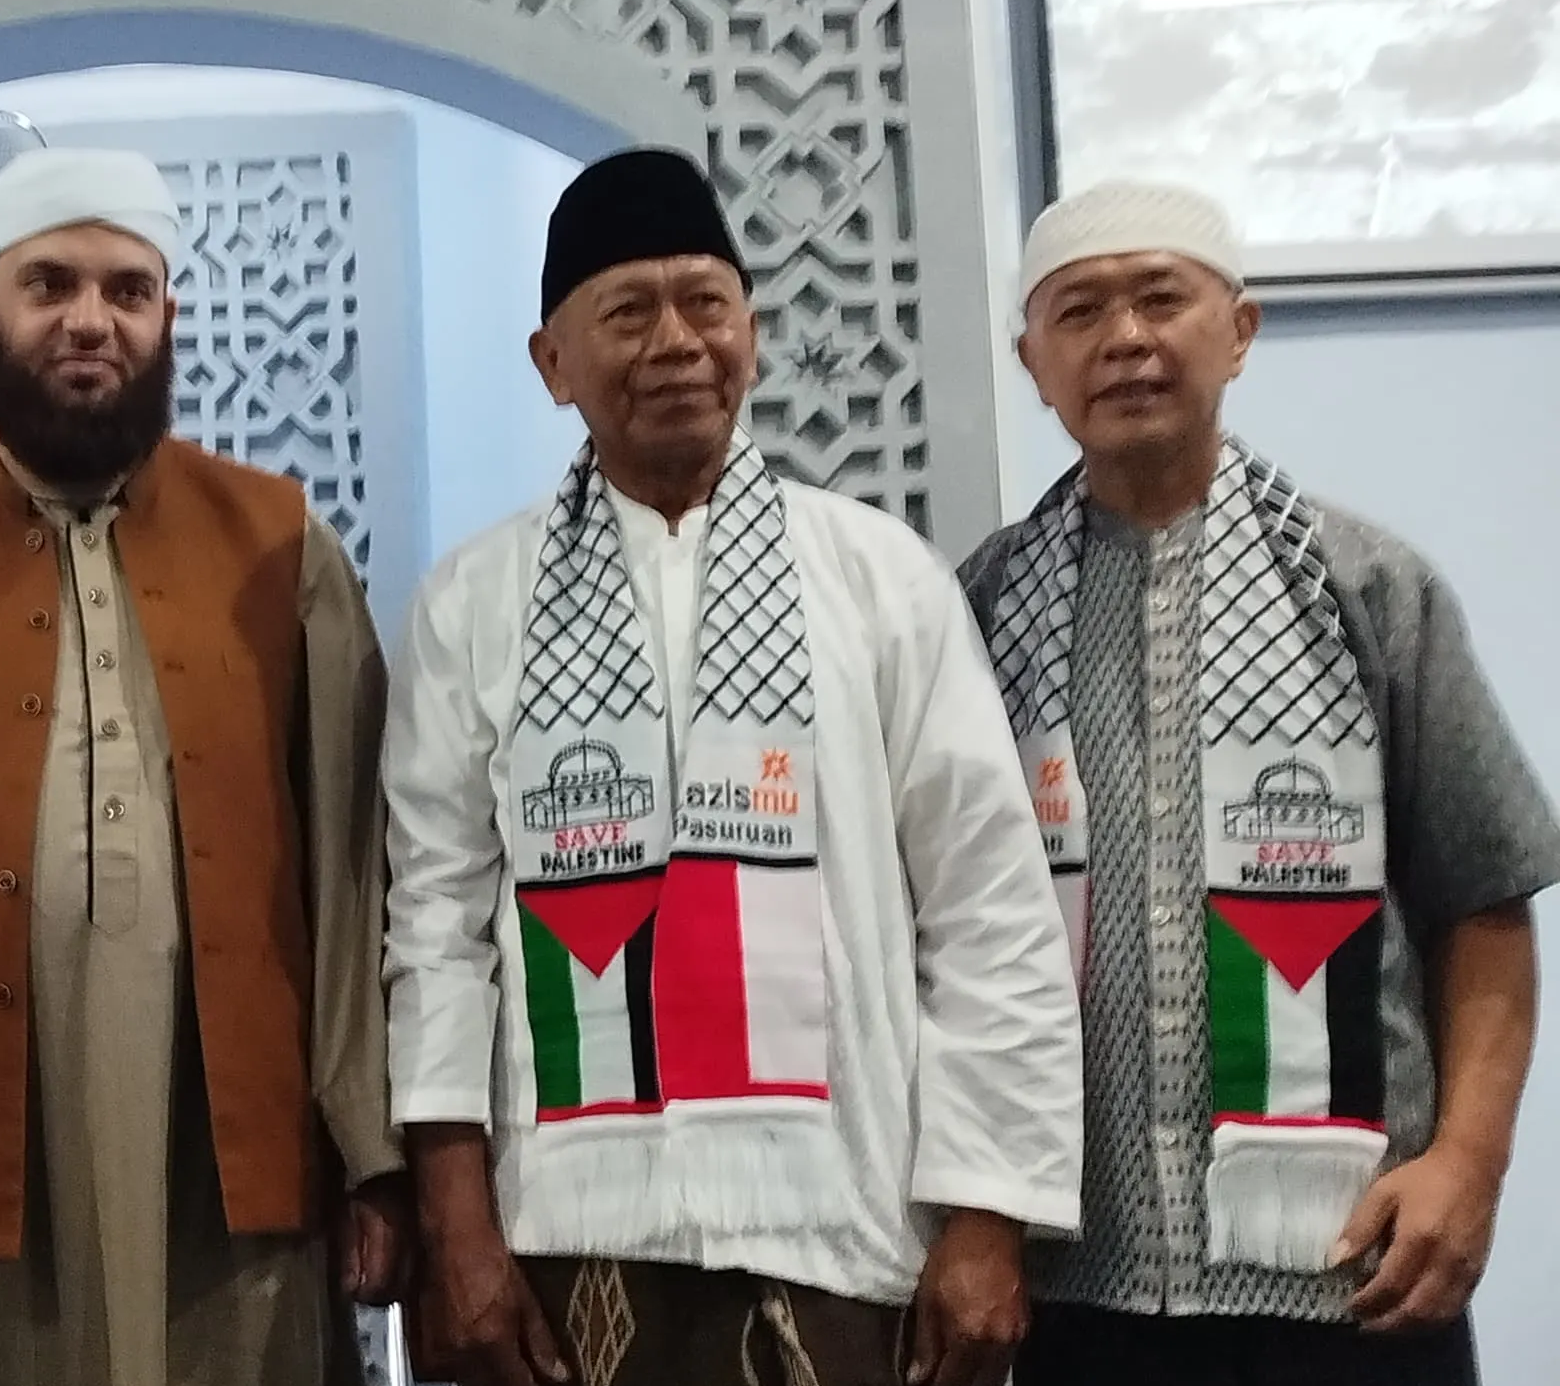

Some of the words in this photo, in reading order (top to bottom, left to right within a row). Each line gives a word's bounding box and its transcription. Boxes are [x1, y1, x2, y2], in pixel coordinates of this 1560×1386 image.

[685, 776, 799, 817] azismu
[554, 819, 628, 851] SAVE
[672, 811, 793, 849] Pasuruan
[540, 841, 646, 875] PALESTINE
[1256, 839, 1335, 865] SAVE
[1239, 861, 1352, 889] PALESTINE
